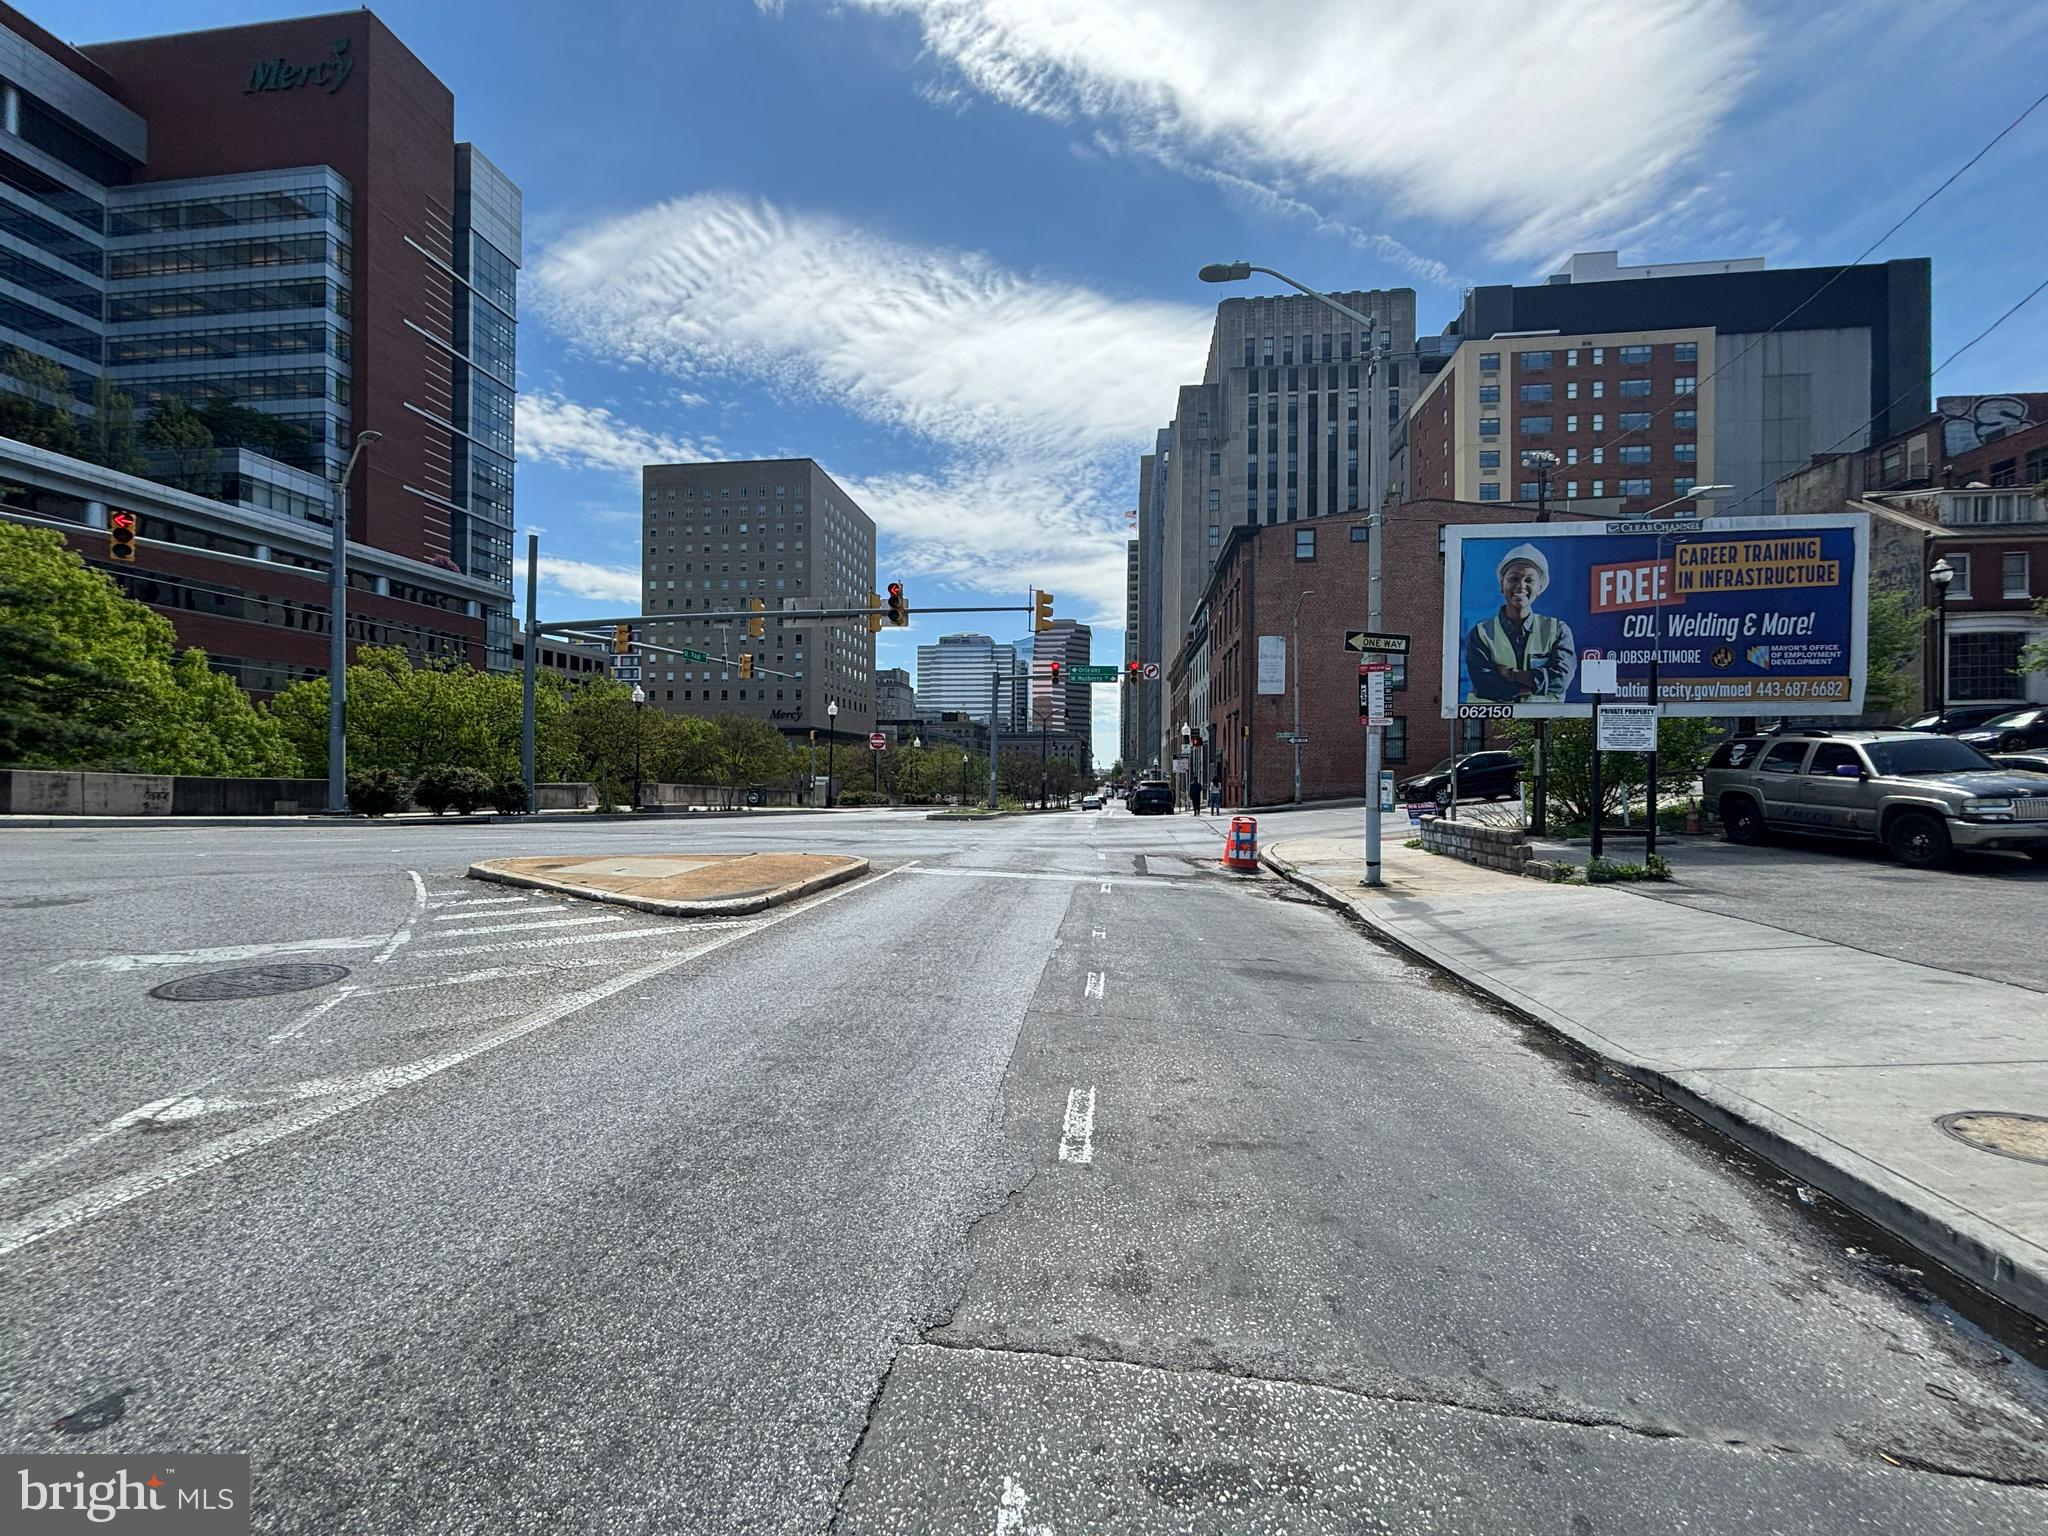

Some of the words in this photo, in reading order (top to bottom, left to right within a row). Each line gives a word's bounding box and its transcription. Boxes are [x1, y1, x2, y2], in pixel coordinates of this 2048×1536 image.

[243, 40, 353, 95] Mercy
[1679, 545, 1737, 566] CAREER
[1743, 541, 1817, 562] TRAINING
[1599, 566, 1667, 606] FREE
[1678, 571, 1693, 589] IN
[1699, 564, 1836, 588] INFRASTRUCTURE
[1668, 612, 1739, 642] Welding
[1743, 613, 1757, 636] &
[1762, 611, 1815, 636] More!
[1363, 638, 1381, 647] ONE
[1384, 639, 1404, 648] WAY
[1771, 658, 1833, 666] DEVELOPMENT
[1615, 681, 1752, 701] baltimrecity.gov/moed
[1756, 681, 1843, 697] 443-687-6682
[769, 706, 803, 722] Mercy
[1459, 705, 1512, 719] 062150
